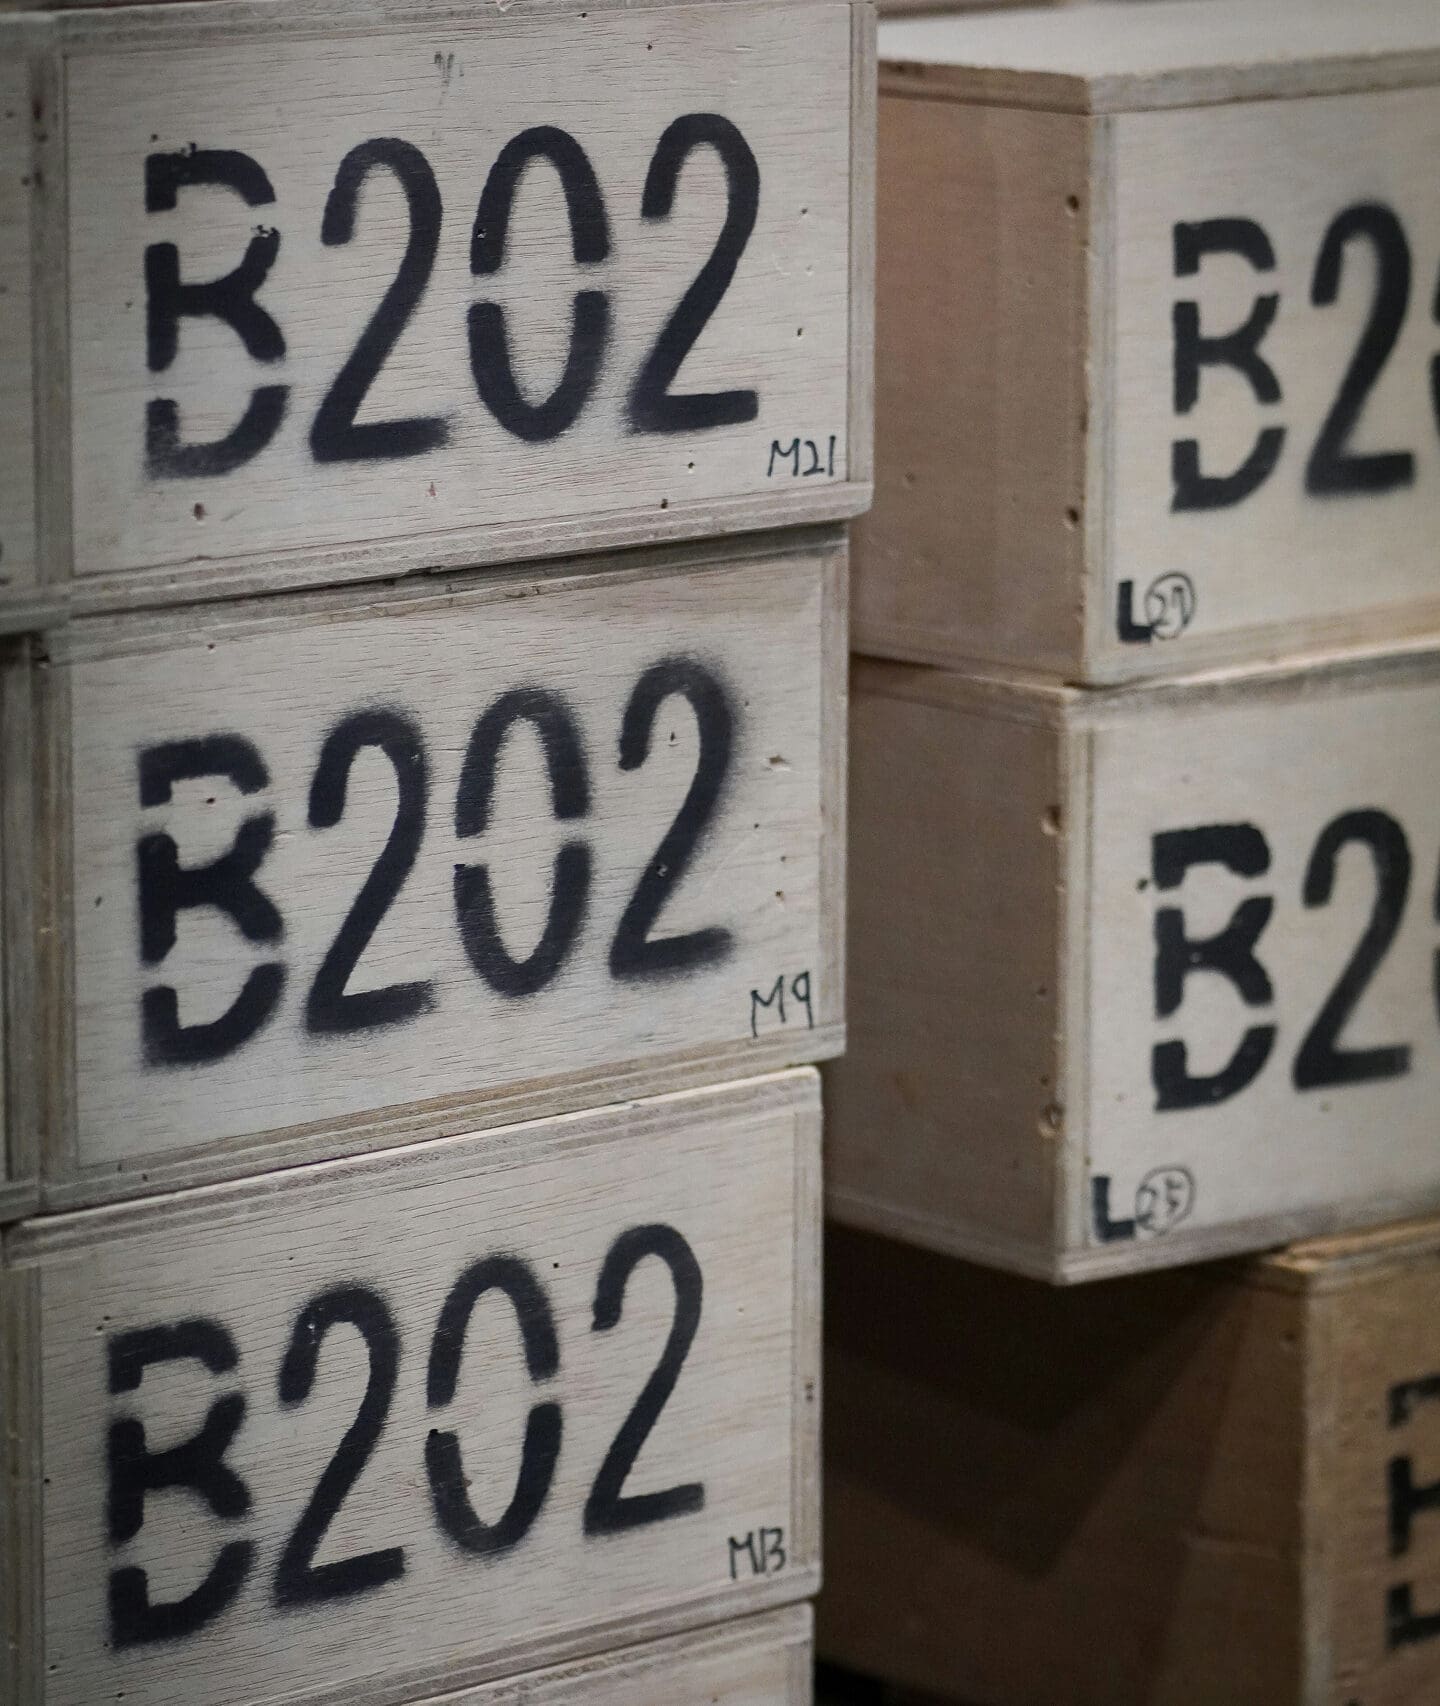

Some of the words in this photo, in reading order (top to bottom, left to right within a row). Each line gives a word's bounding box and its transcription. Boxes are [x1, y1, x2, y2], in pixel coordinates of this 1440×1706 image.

[145, 113, 760, 479] B202
[1170, 202, 1440, 514] B2
[766, 434, 837, 477] M21
[137, 651, 738, 1067] B202
[750, 971, 813, 1038] M9
[1151, 807, 1440, 1114] B2
[107, 1223, 704, 1648] B202
